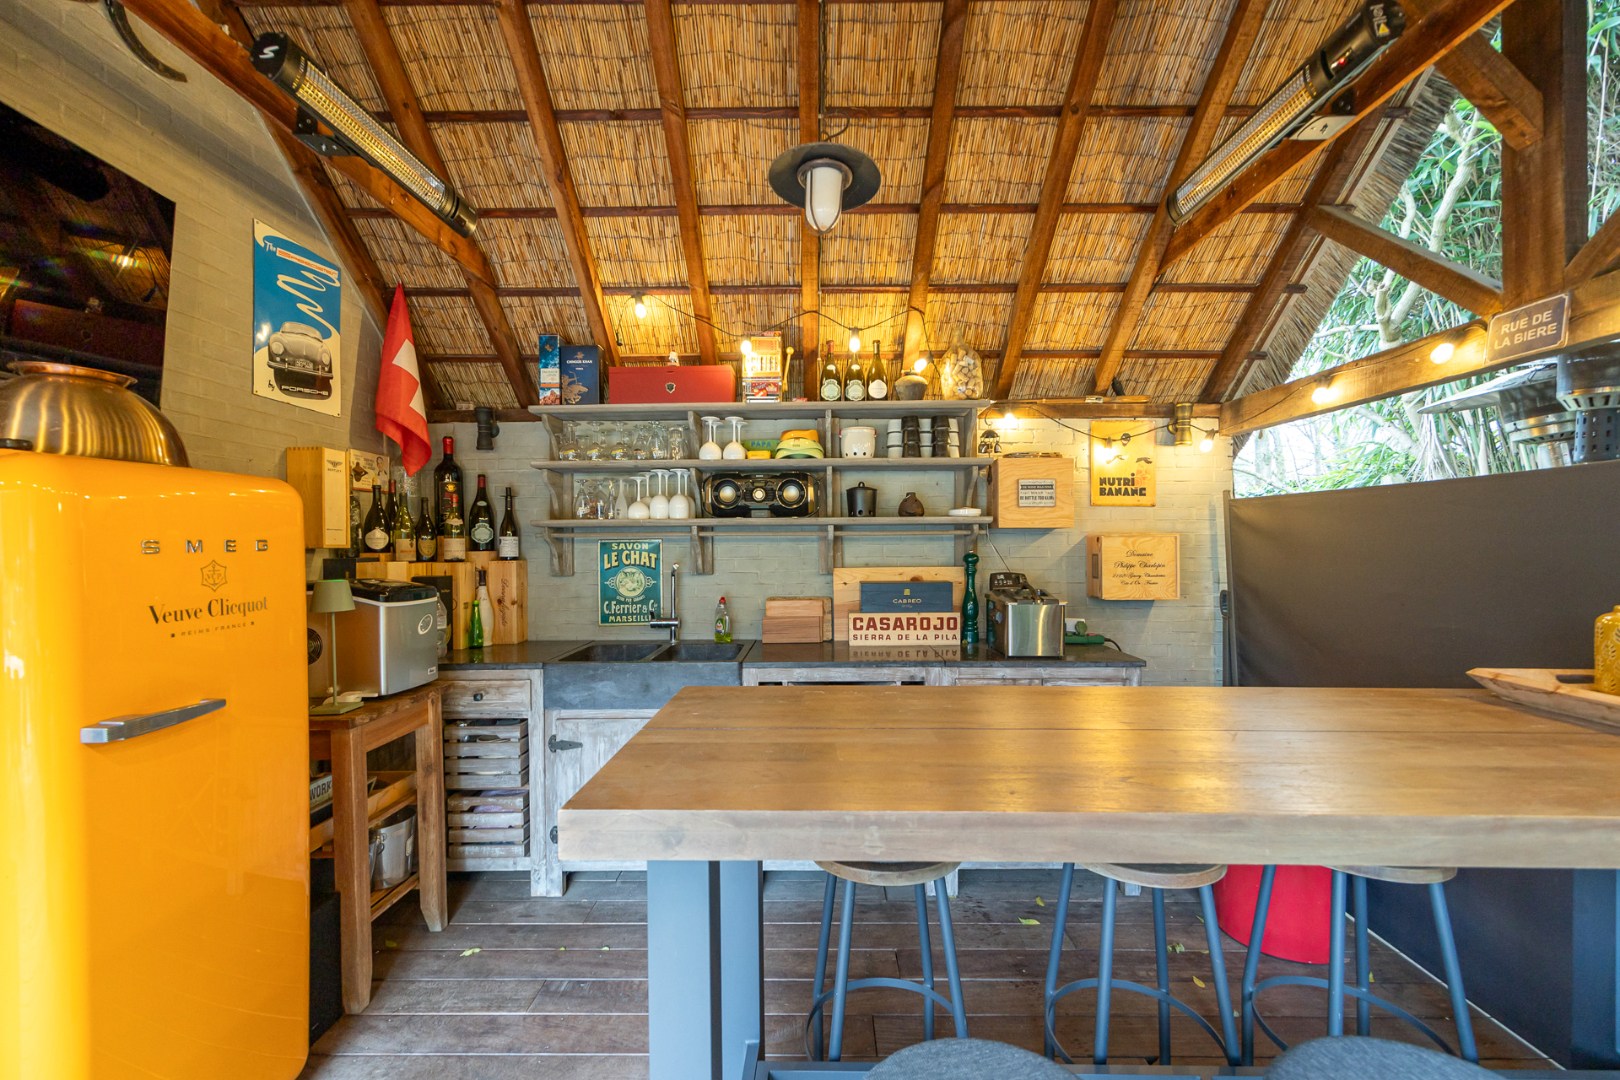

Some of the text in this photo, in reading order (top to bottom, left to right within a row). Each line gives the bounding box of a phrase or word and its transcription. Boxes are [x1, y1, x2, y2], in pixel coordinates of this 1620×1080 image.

[1500, 310, 1553, 335] RUE DE
[1494, 322, 1558, 350] LA BIERE
[281, 385, 329, 396] PORSCHE
[1099, 487, 1146, 496] BANANE
[141, 539, 269, 554] SMEG
[604, 550, 657, 569] LE CHAT
[149, 596, 268, 624] Veuve Clicquot
[852, 616, 958, 631] CASAROJO
[310, 780, 331, 800] WORK
